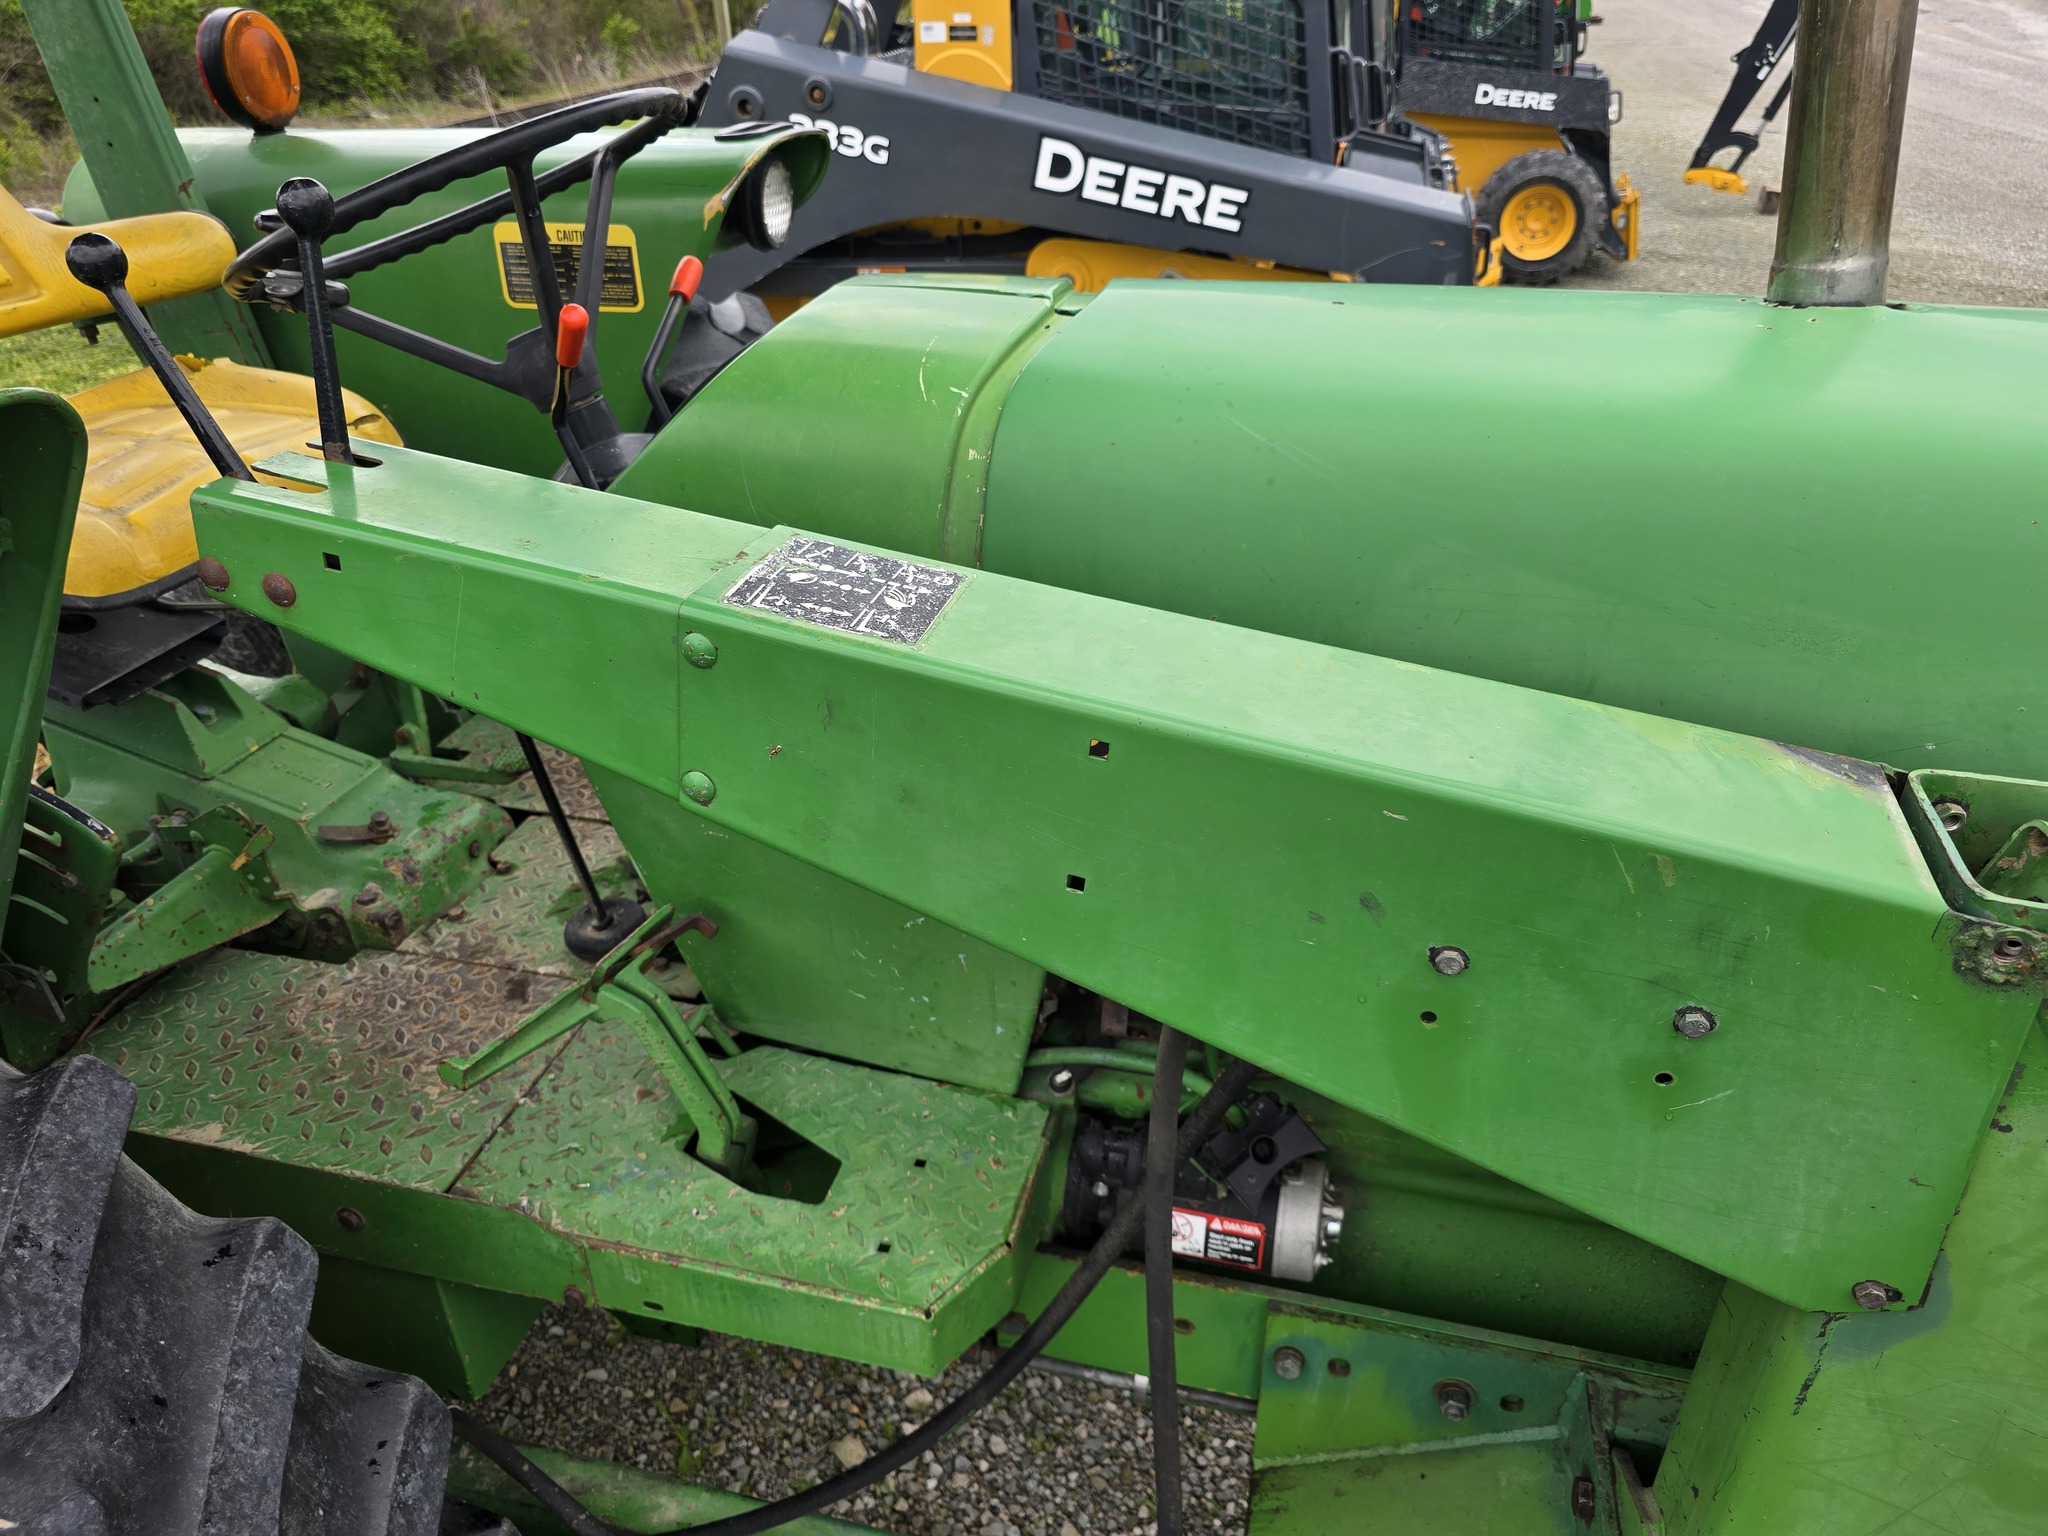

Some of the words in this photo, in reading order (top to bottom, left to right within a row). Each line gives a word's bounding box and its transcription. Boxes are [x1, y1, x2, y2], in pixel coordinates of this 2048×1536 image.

[1474, 83, 1557, 111] DEERE
[1033, 136, 1249, 233] DEERE
[556, 230, 584, 243] CAUTI
